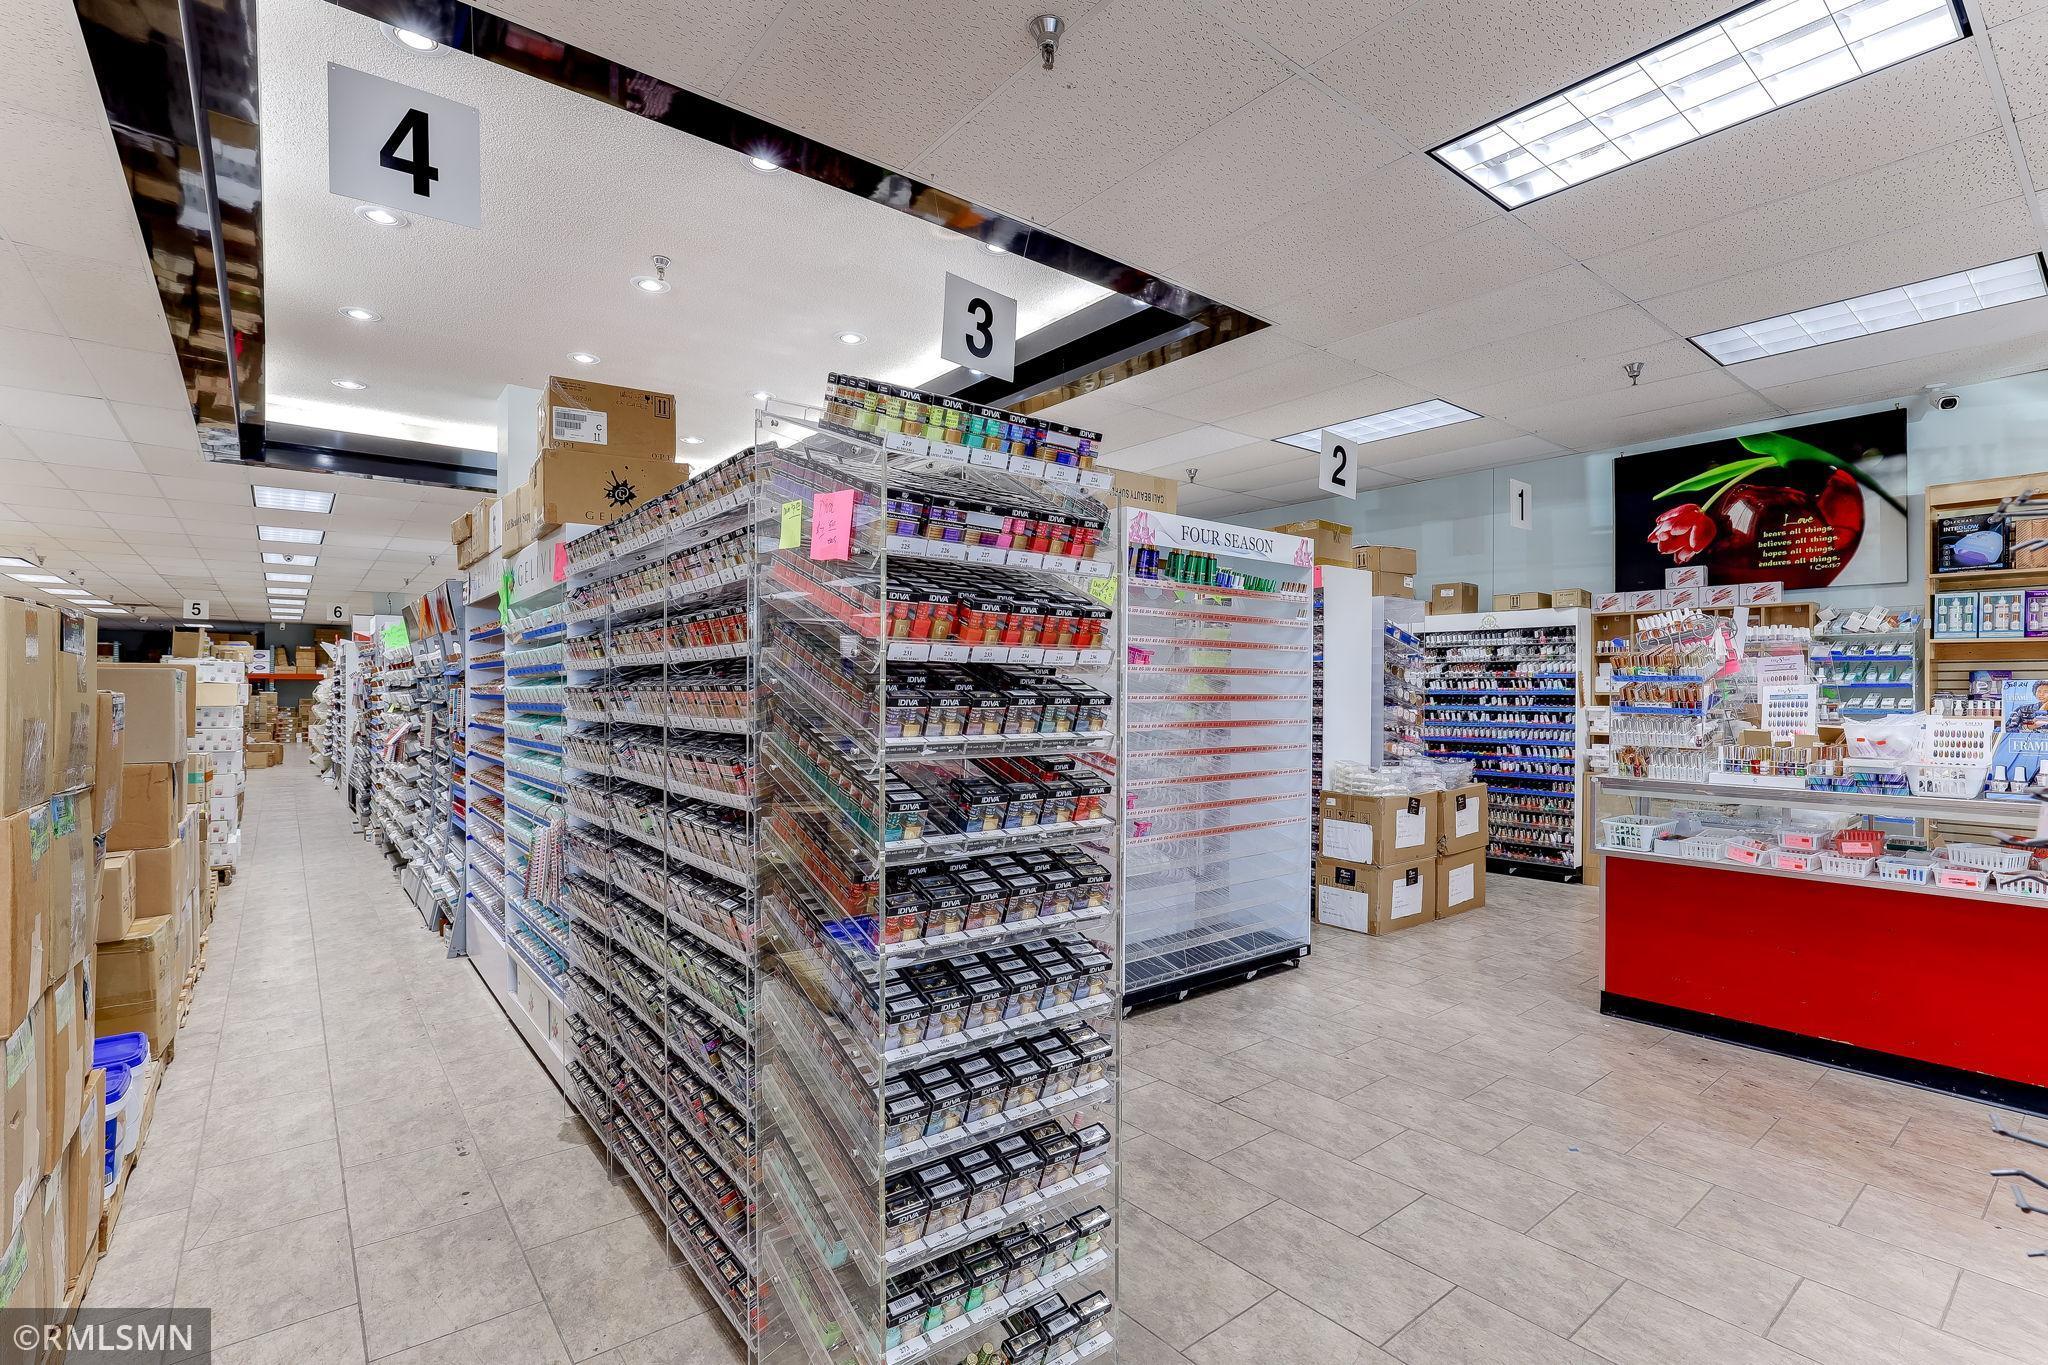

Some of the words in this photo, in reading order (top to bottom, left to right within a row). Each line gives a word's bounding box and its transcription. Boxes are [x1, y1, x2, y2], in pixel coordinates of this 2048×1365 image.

[379, 108, 439, 197] 4
[966, 298, 993, 358] 3
[1332, 445, 1346, 487] 2
[1519, 488, 1524, 520] 1
[1783, 514, 1813, 526] Love
[1182, 525, 1220, 546] FOUR
[1224, 533, 1273, 553] SEASON
[1758, 540, 1792, 548] believes
[1759, 560, 1792, 568] endures
[192, 603, 201, 616] 5
[333, 606, 342, 619] 6
